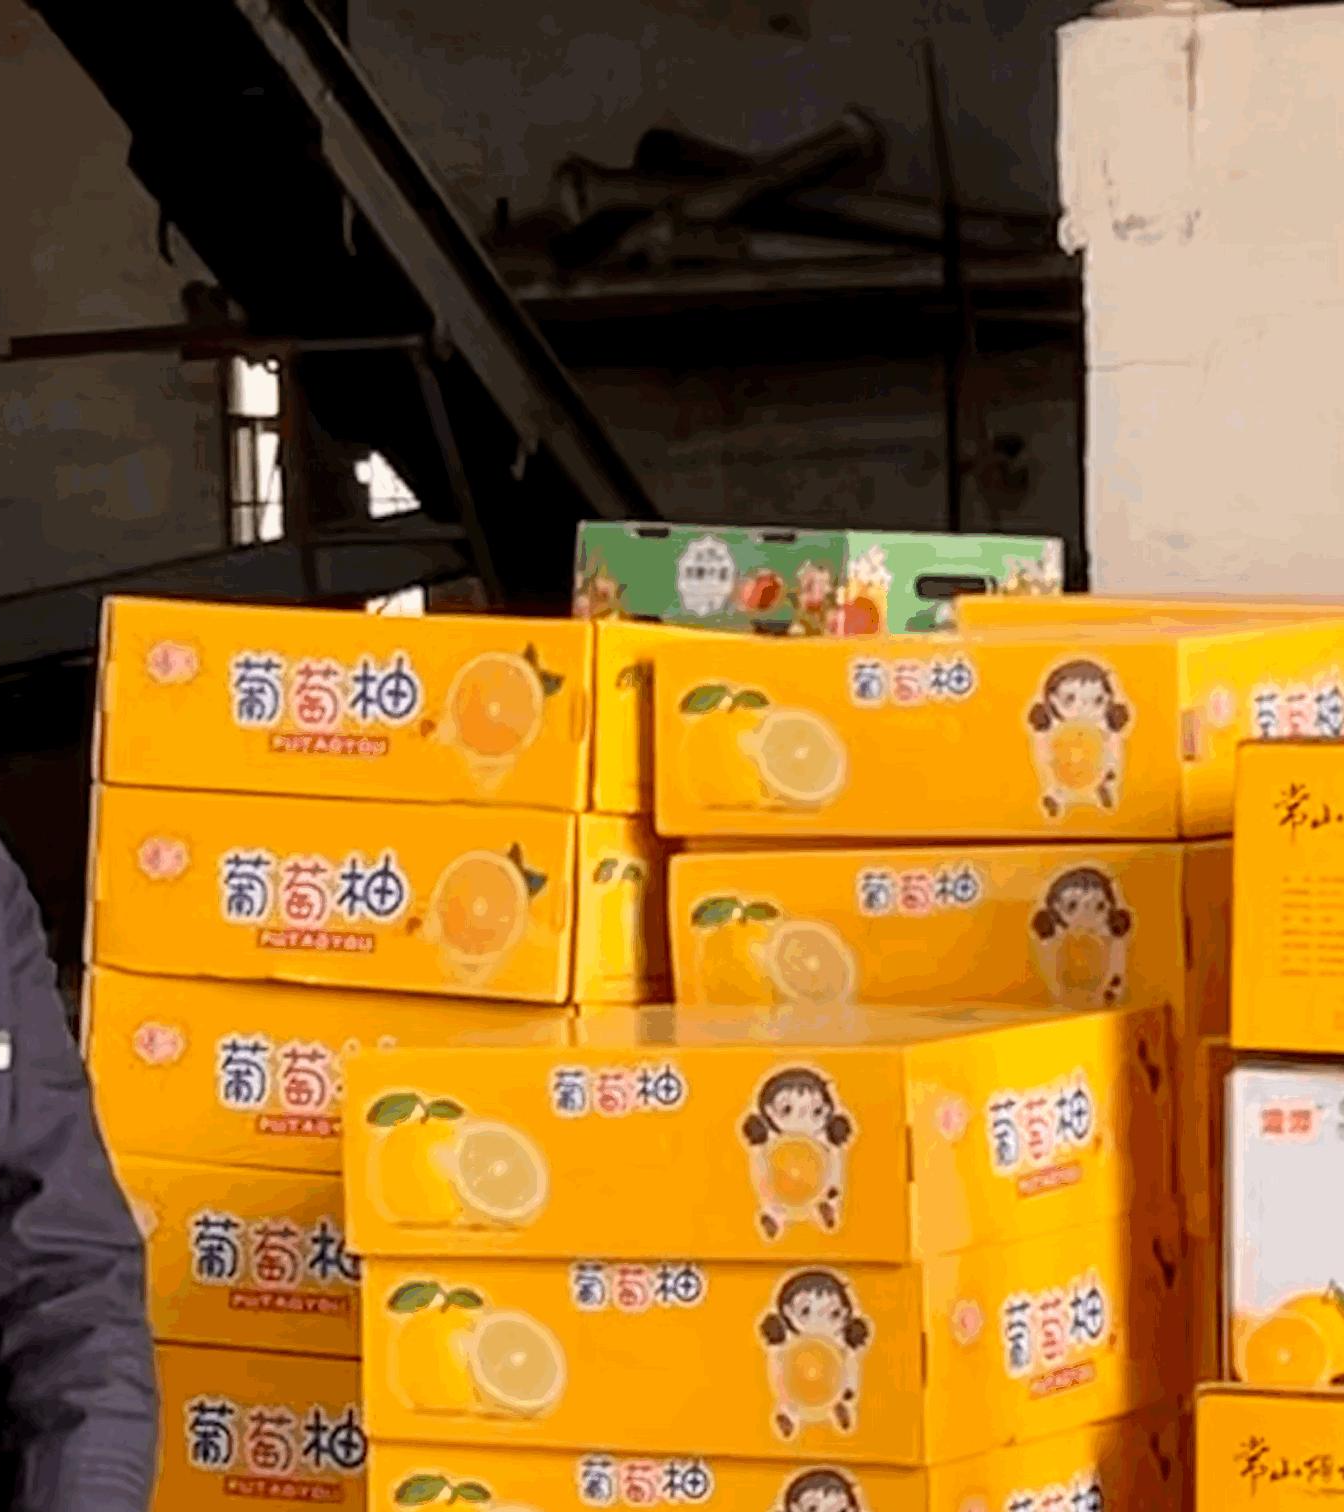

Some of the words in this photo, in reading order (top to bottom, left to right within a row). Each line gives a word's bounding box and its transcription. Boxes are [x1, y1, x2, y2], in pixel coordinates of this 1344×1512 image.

[233, 655, 419, 725] 葡萄柚
[223, 854, 405, 922] 葡萄柚
[220, 1037, 346, 1107] 葡萄
[555, 1066, 682, 1113] 葡萄柚
[190, 1402, 368, 1477] 葡萄柚
[584, 1459, 709, 1502] 葡萄柚
